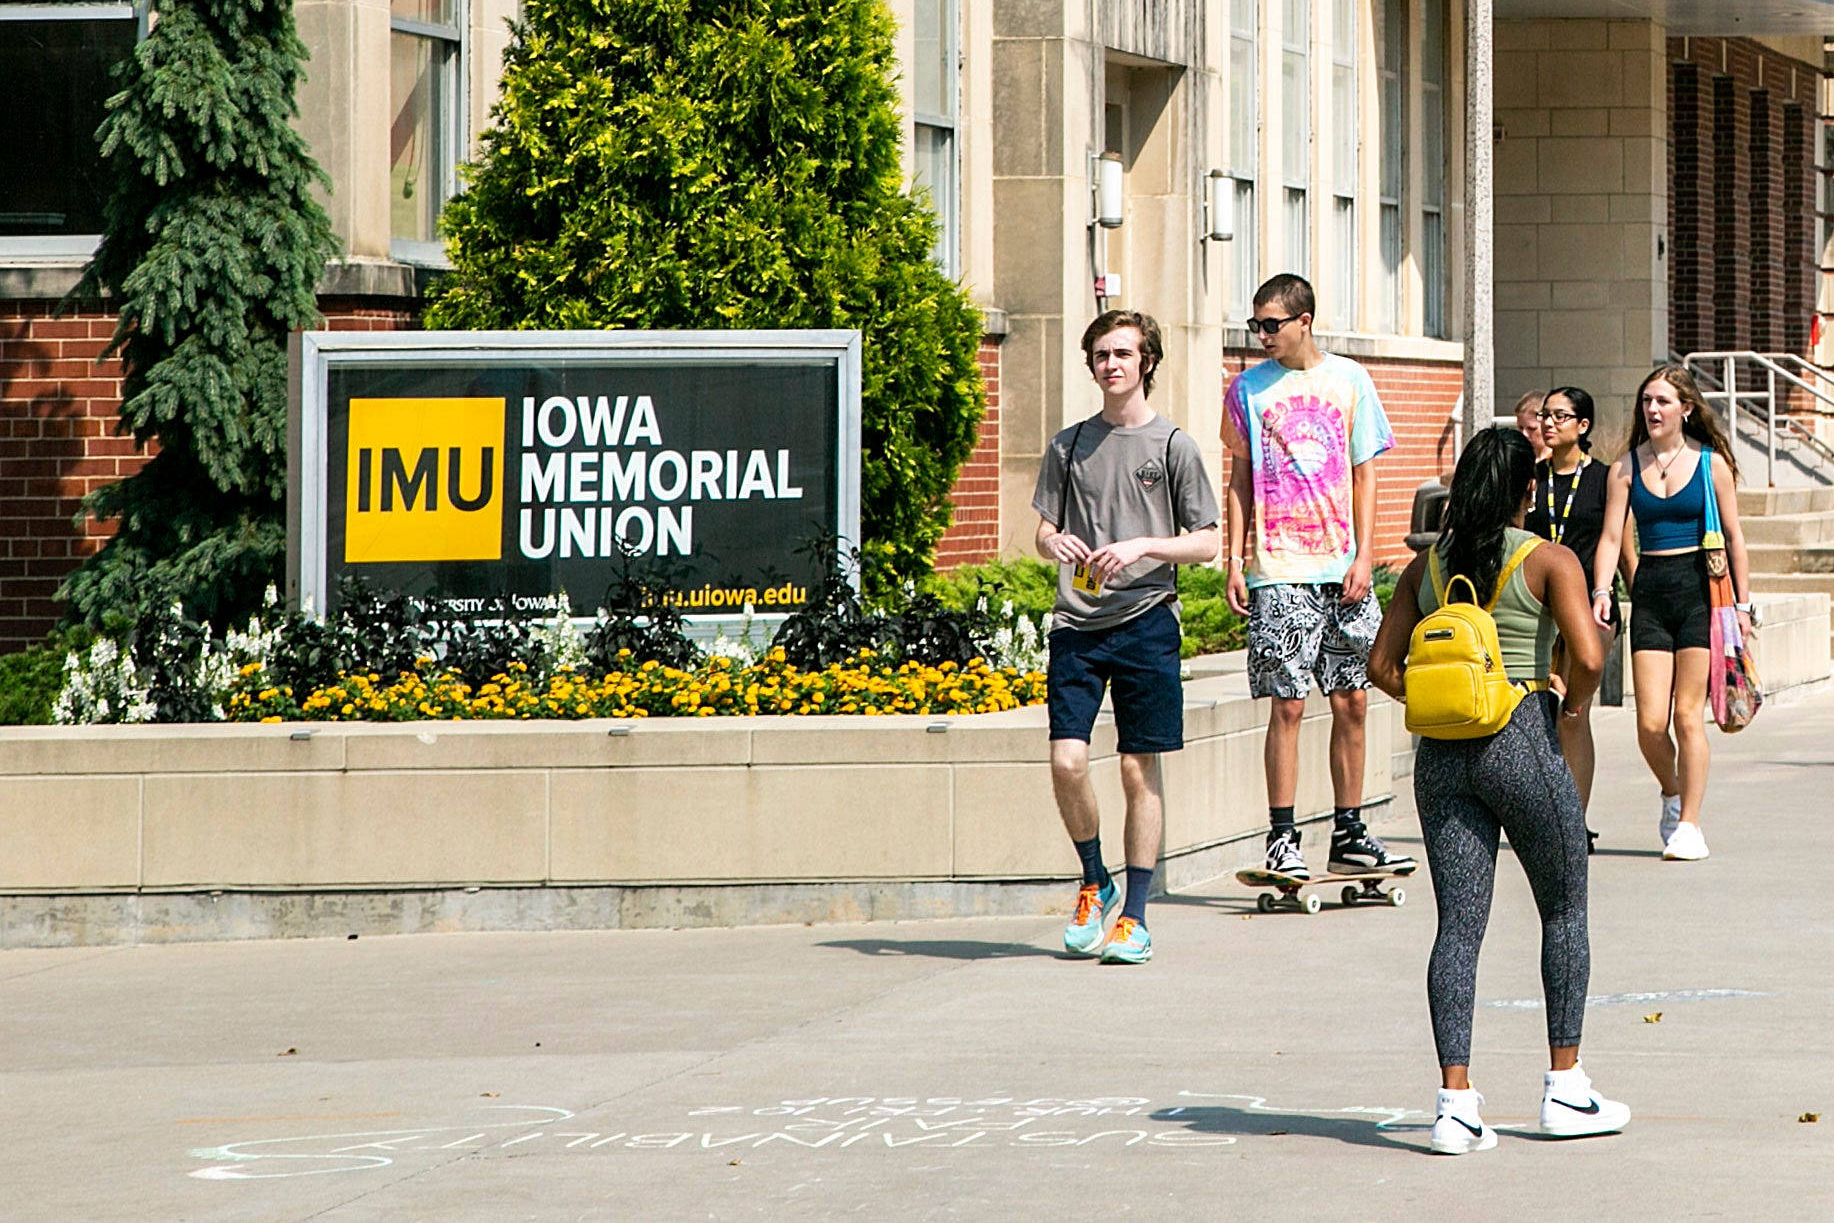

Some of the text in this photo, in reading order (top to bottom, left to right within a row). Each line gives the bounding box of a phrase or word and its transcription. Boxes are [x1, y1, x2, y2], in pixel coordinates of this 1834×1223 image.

[521, 395, 663, 448] IOWA
[357, 446, 494, 513] IMU
[519, 449, 803, 504] MEMORIAL
[518, 505, 693, 560] UNION
[330, 1129, 1238, 1153] SUSTAINABILITY
[783, 1116, 1037, 1131] FAIR
